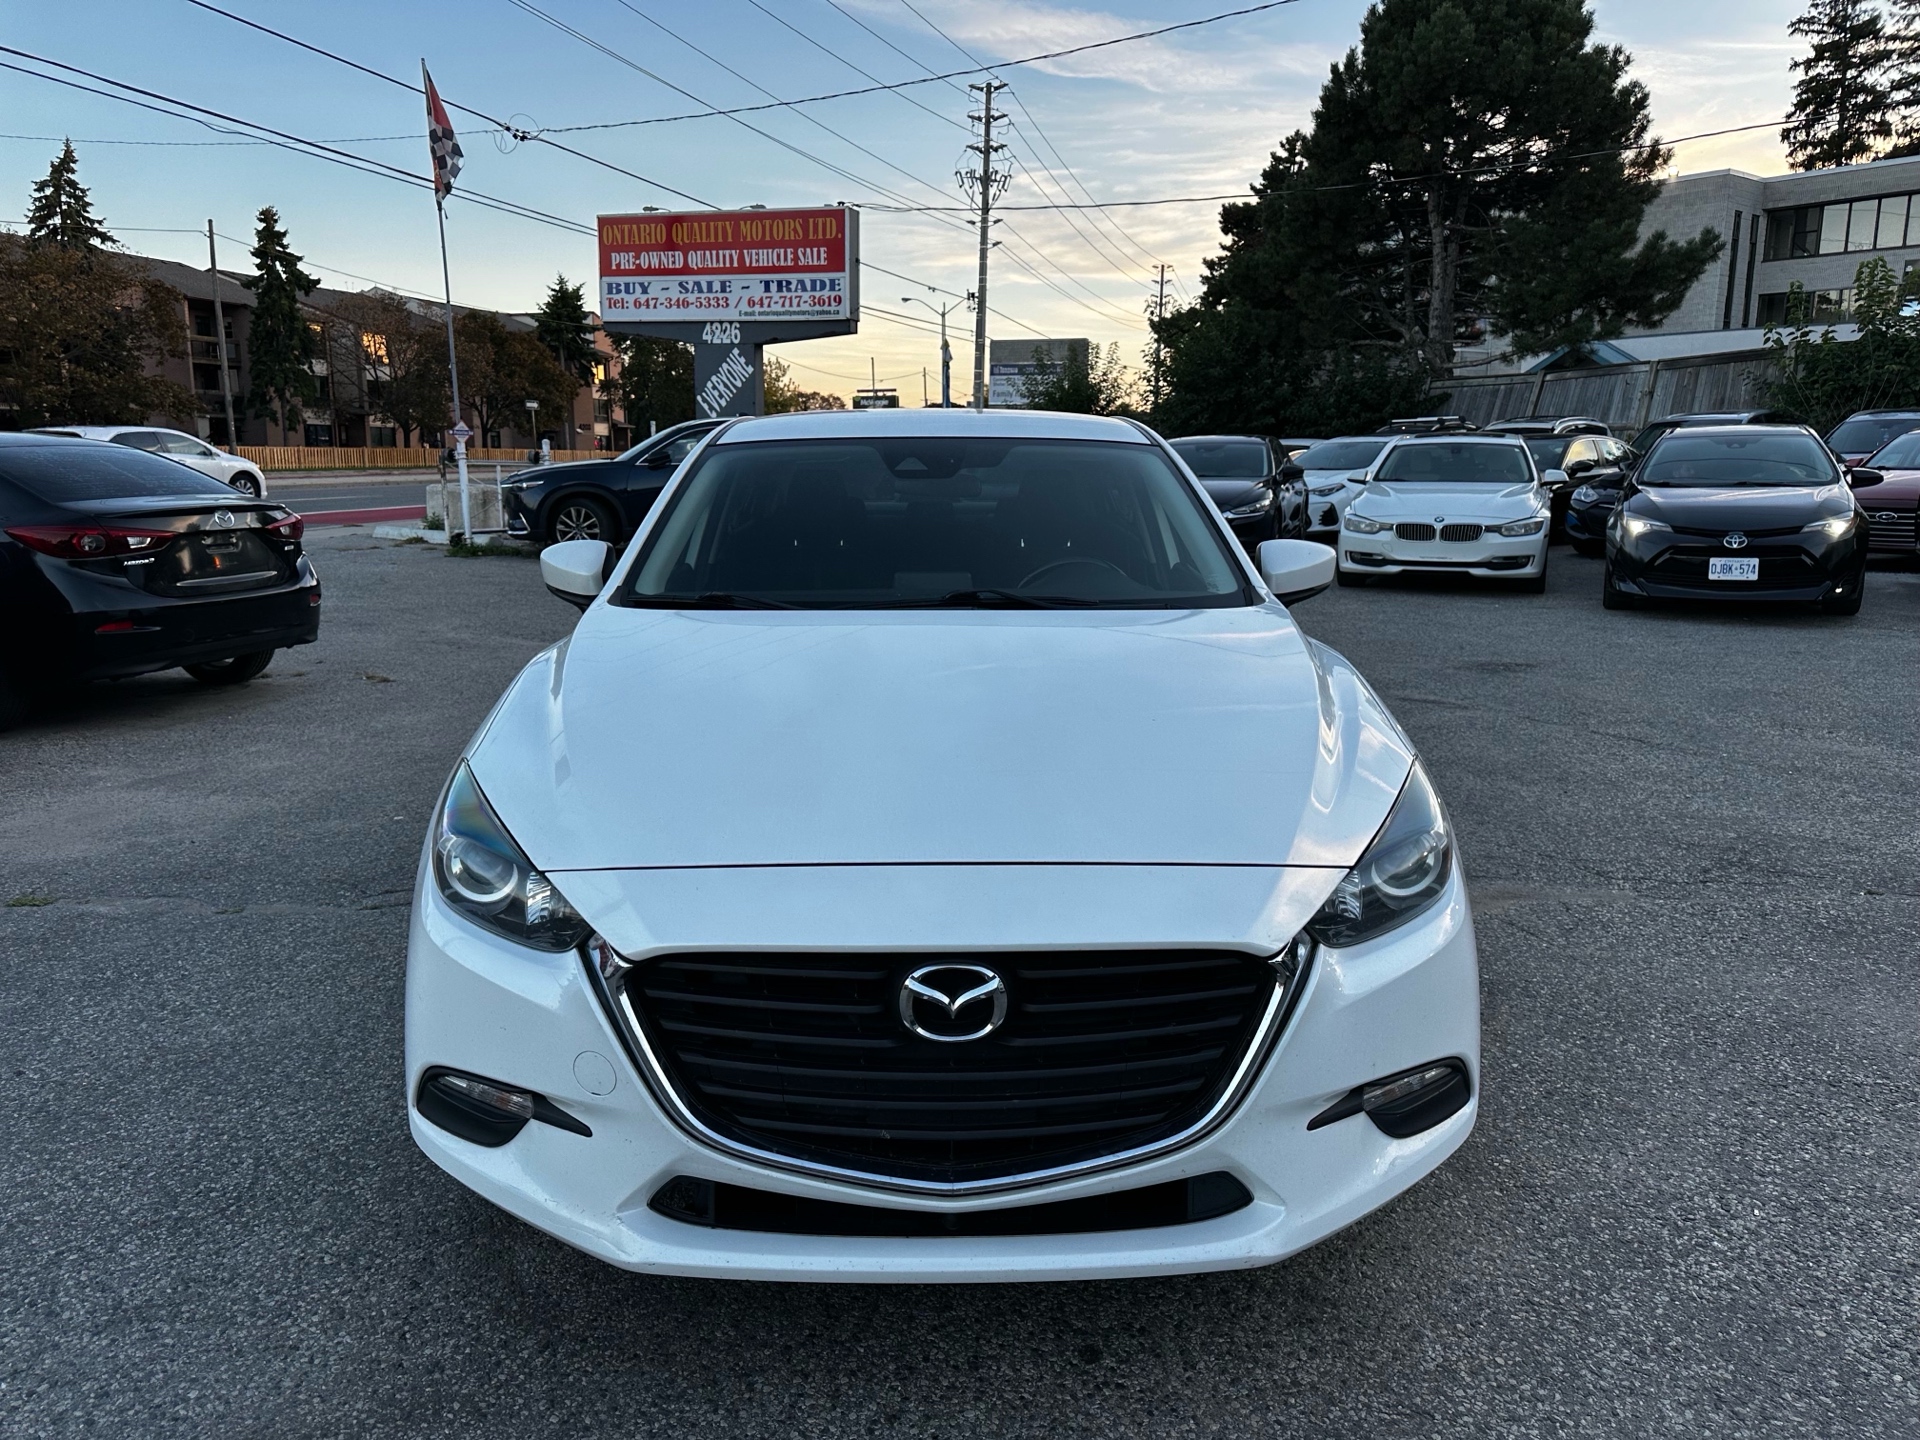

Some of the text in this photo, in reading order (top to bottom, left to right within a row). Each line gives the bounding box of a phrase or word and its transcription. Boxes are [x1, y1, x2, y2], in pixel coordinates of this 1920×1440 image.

[602, 217, 842, 246] ONTARIO QUALITY MOTORS LTD.
[611, 246, 828, 270] PRE-OWNED QUALITY VEHICLE SALE
[606, 281, 652, 295] BUY
[677, 280, 733, 295] SALE
[759, 278, 842, 294] TRADE
[606, 294, 843, 310] Tel: 647-346-5333 / 647-717-3619
[702, 321, 741, 344] 4226
[696, 347, 755, 418] EVERYONE
[1739, 563, 1756, 575] 574
